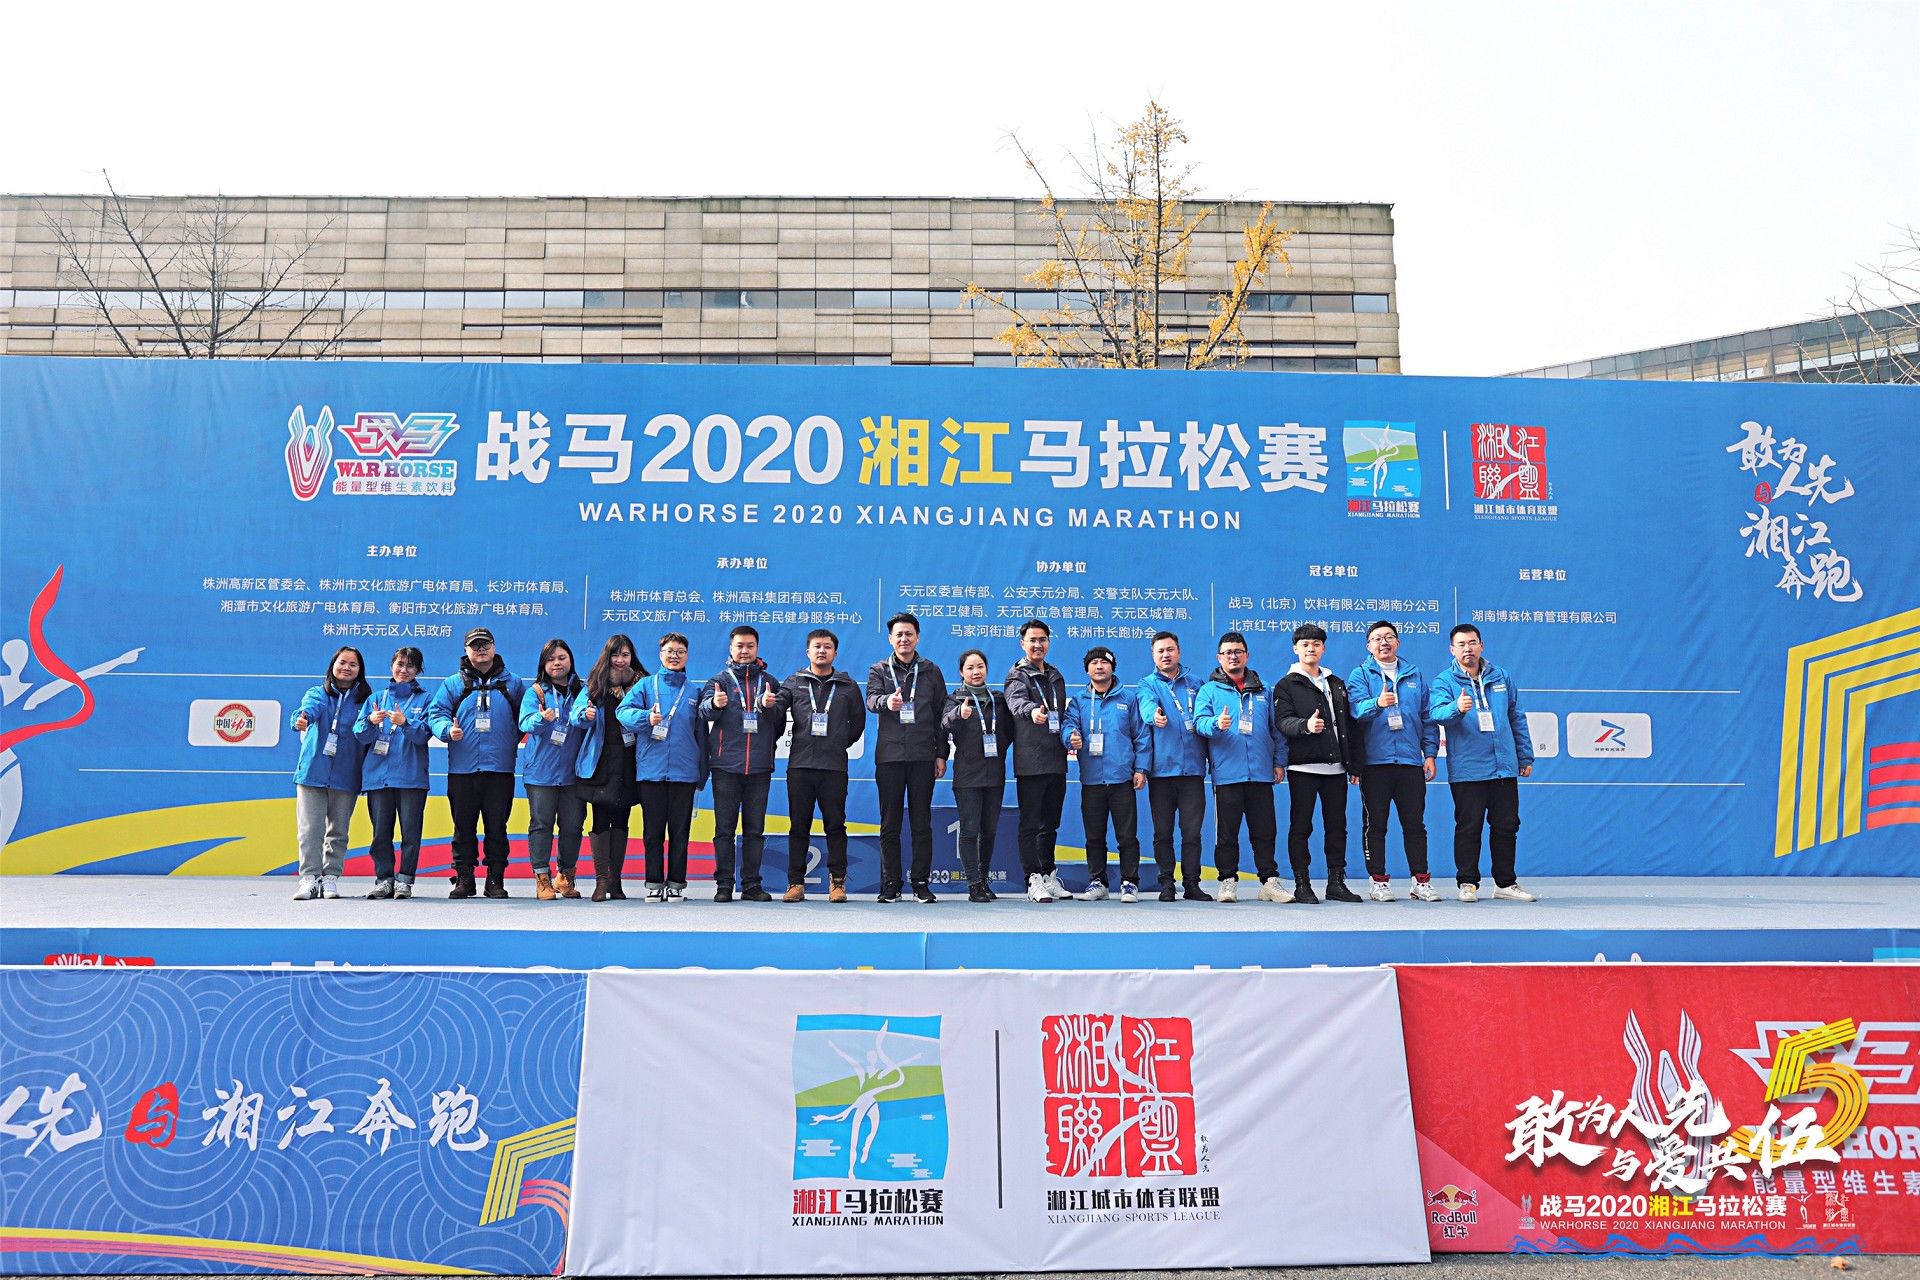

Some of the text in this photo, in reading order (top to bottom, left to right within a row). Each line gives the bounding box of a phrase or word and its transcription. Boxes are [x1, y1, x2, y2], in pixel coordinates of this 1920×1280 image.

[475, 410, 1329, 494] 战马2020湘江马拉松赛
[336, 461, 455, 478] WAR HORSE
[335, 480, 454, 493] 能量型维生素饮料
[579, 502, 1241, 530] WARHORSE 2020 XIANGJIANG MARATHON
[366, 545, 418, 558] 主办单位
[716, 557, 768, 570] 承办单位
[1036, 560, 1087, 573] 协办单位
[1309, 565, 1359, 578] 冠名单位
[1519, 568, 1567, 582] 运营单位
[1472, 609, 1618, 625] 湖南博森体育管理有限公司
[323, 622, 452, 638] 株洲市天元区人民政府
[792, 1188, 944, 1215] 湘江马拉松赛
[1047, 1186, 1221, 1211] 湘江城市体育联盟
[792, 1215, 944, 1227] XIANGJIANG MARATHON
[1048, 1211, 1221, 1224] XIANGJIANG SPORTS LEAGUE
[1431, 1210, 1477, 1224] RedBull
[1443, 1225, 1468, 1238] 红牛
